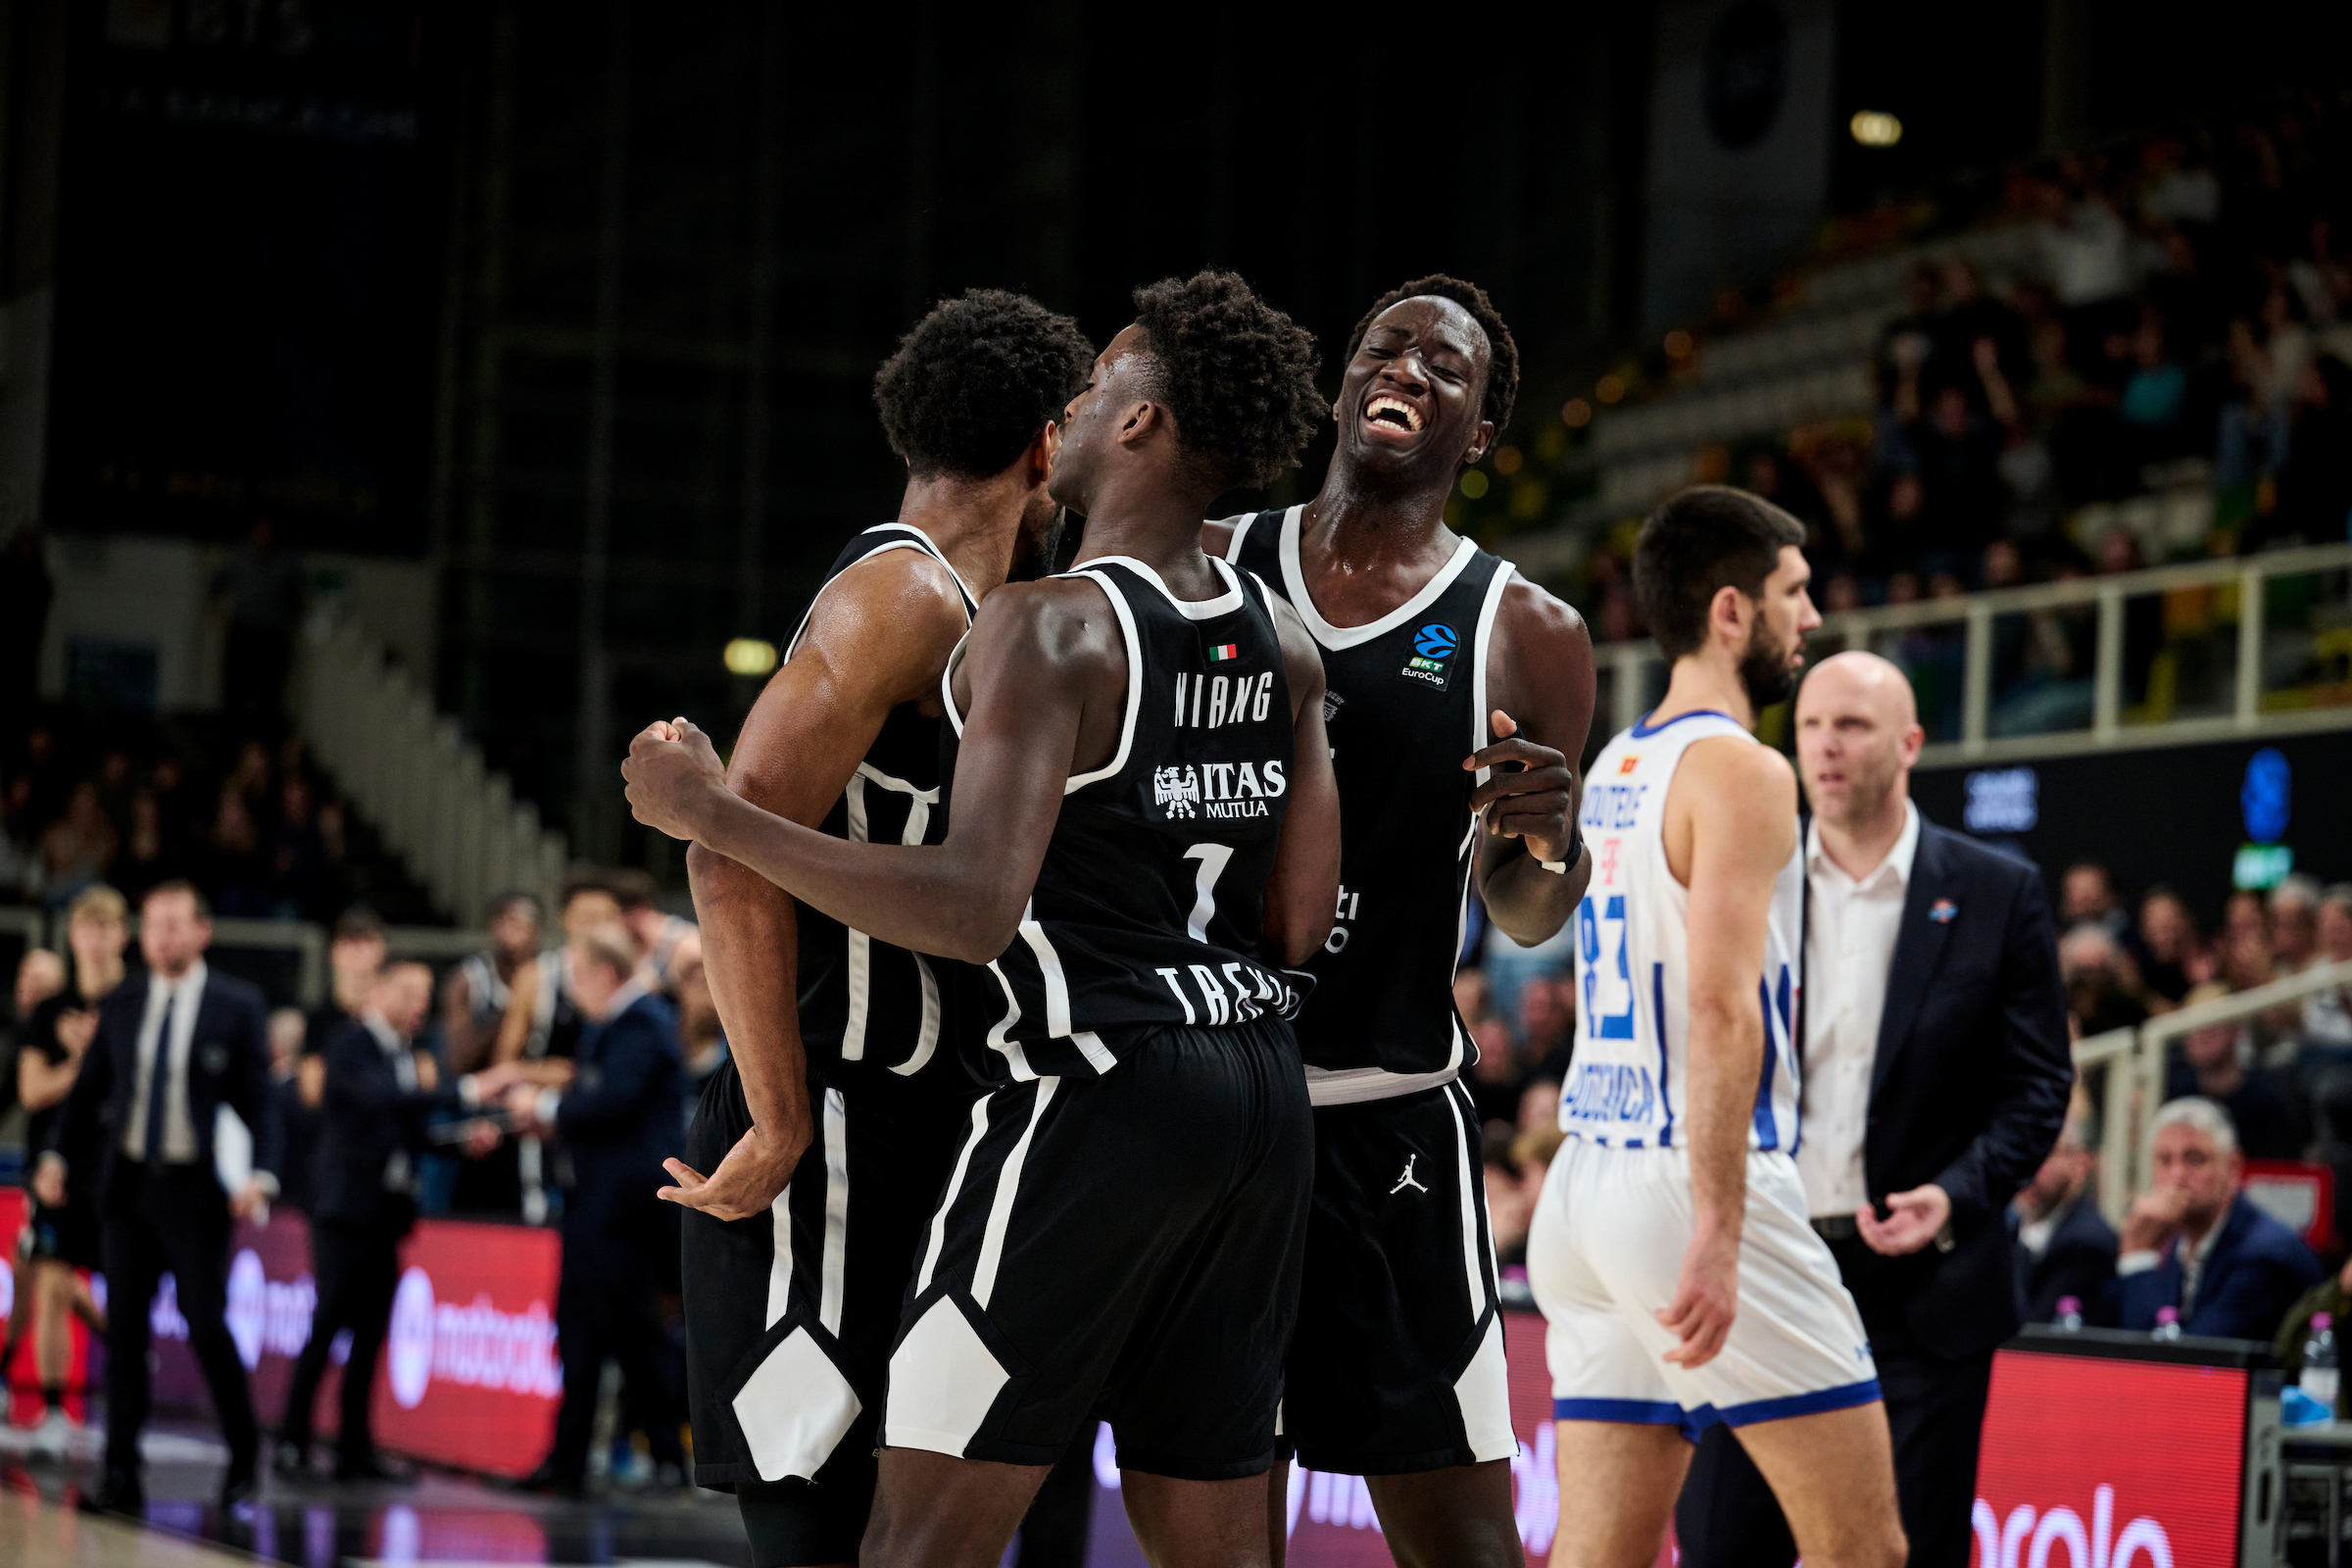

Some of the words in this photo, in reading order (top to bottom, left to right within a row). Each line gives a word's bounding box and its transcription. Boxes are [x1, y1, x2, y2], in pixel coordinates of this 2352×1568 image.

[1401, 667, 1445, 686] EuroCup
[1409, 658, 1444, 672] BKT
[1174, 671, 1273, 729] NIANG
[1201, 760, 1287, 801] ITAS
[1205, 800, 1269, 819] MUTUA
[1182, 842, 1235, 945] 7
